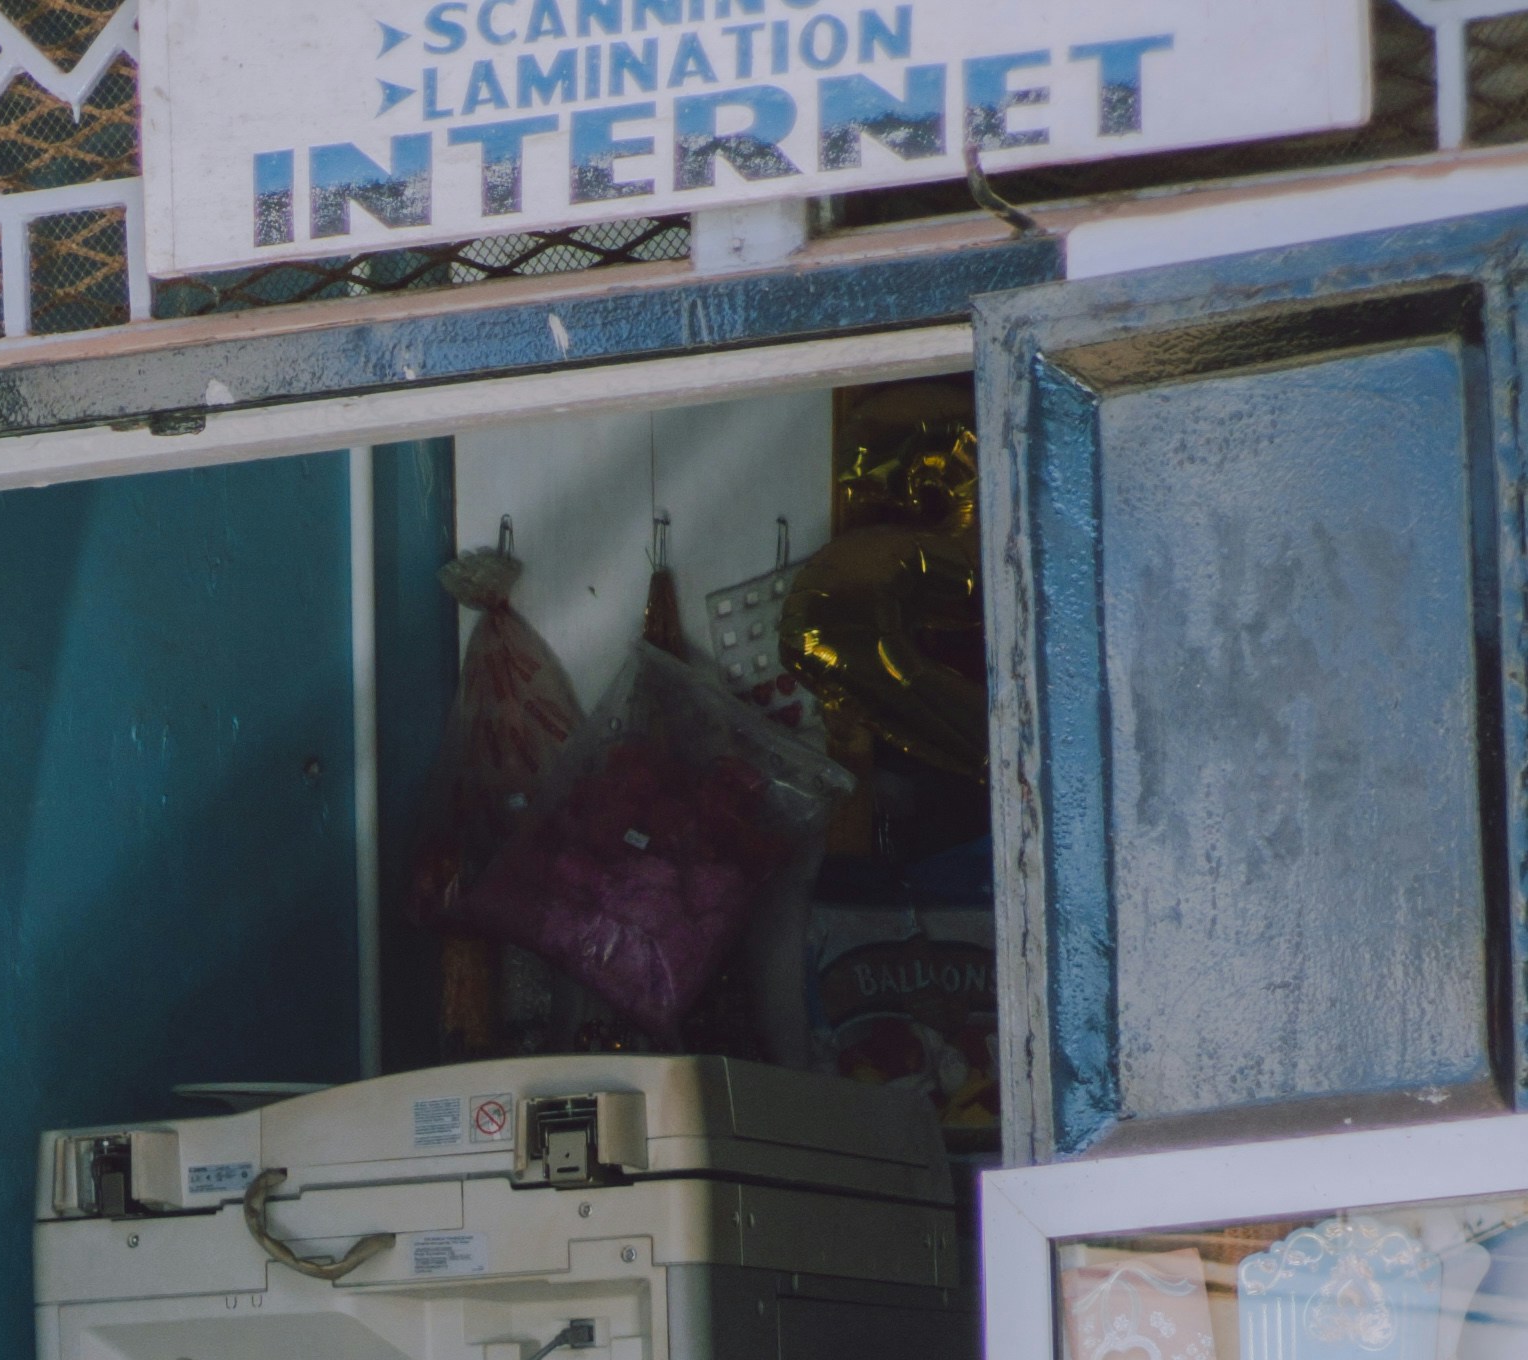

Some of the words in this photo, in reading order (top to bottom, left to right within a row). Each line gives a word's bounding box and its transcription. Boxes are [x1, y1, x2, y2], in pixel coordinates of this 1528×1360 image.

[422, 4, 913, 121] LAMINATION
[423, 0, 819, 55] SCANN
[253, 33, 1174, 248] INTERNET
[852, 959, 997, 997] BALLON
